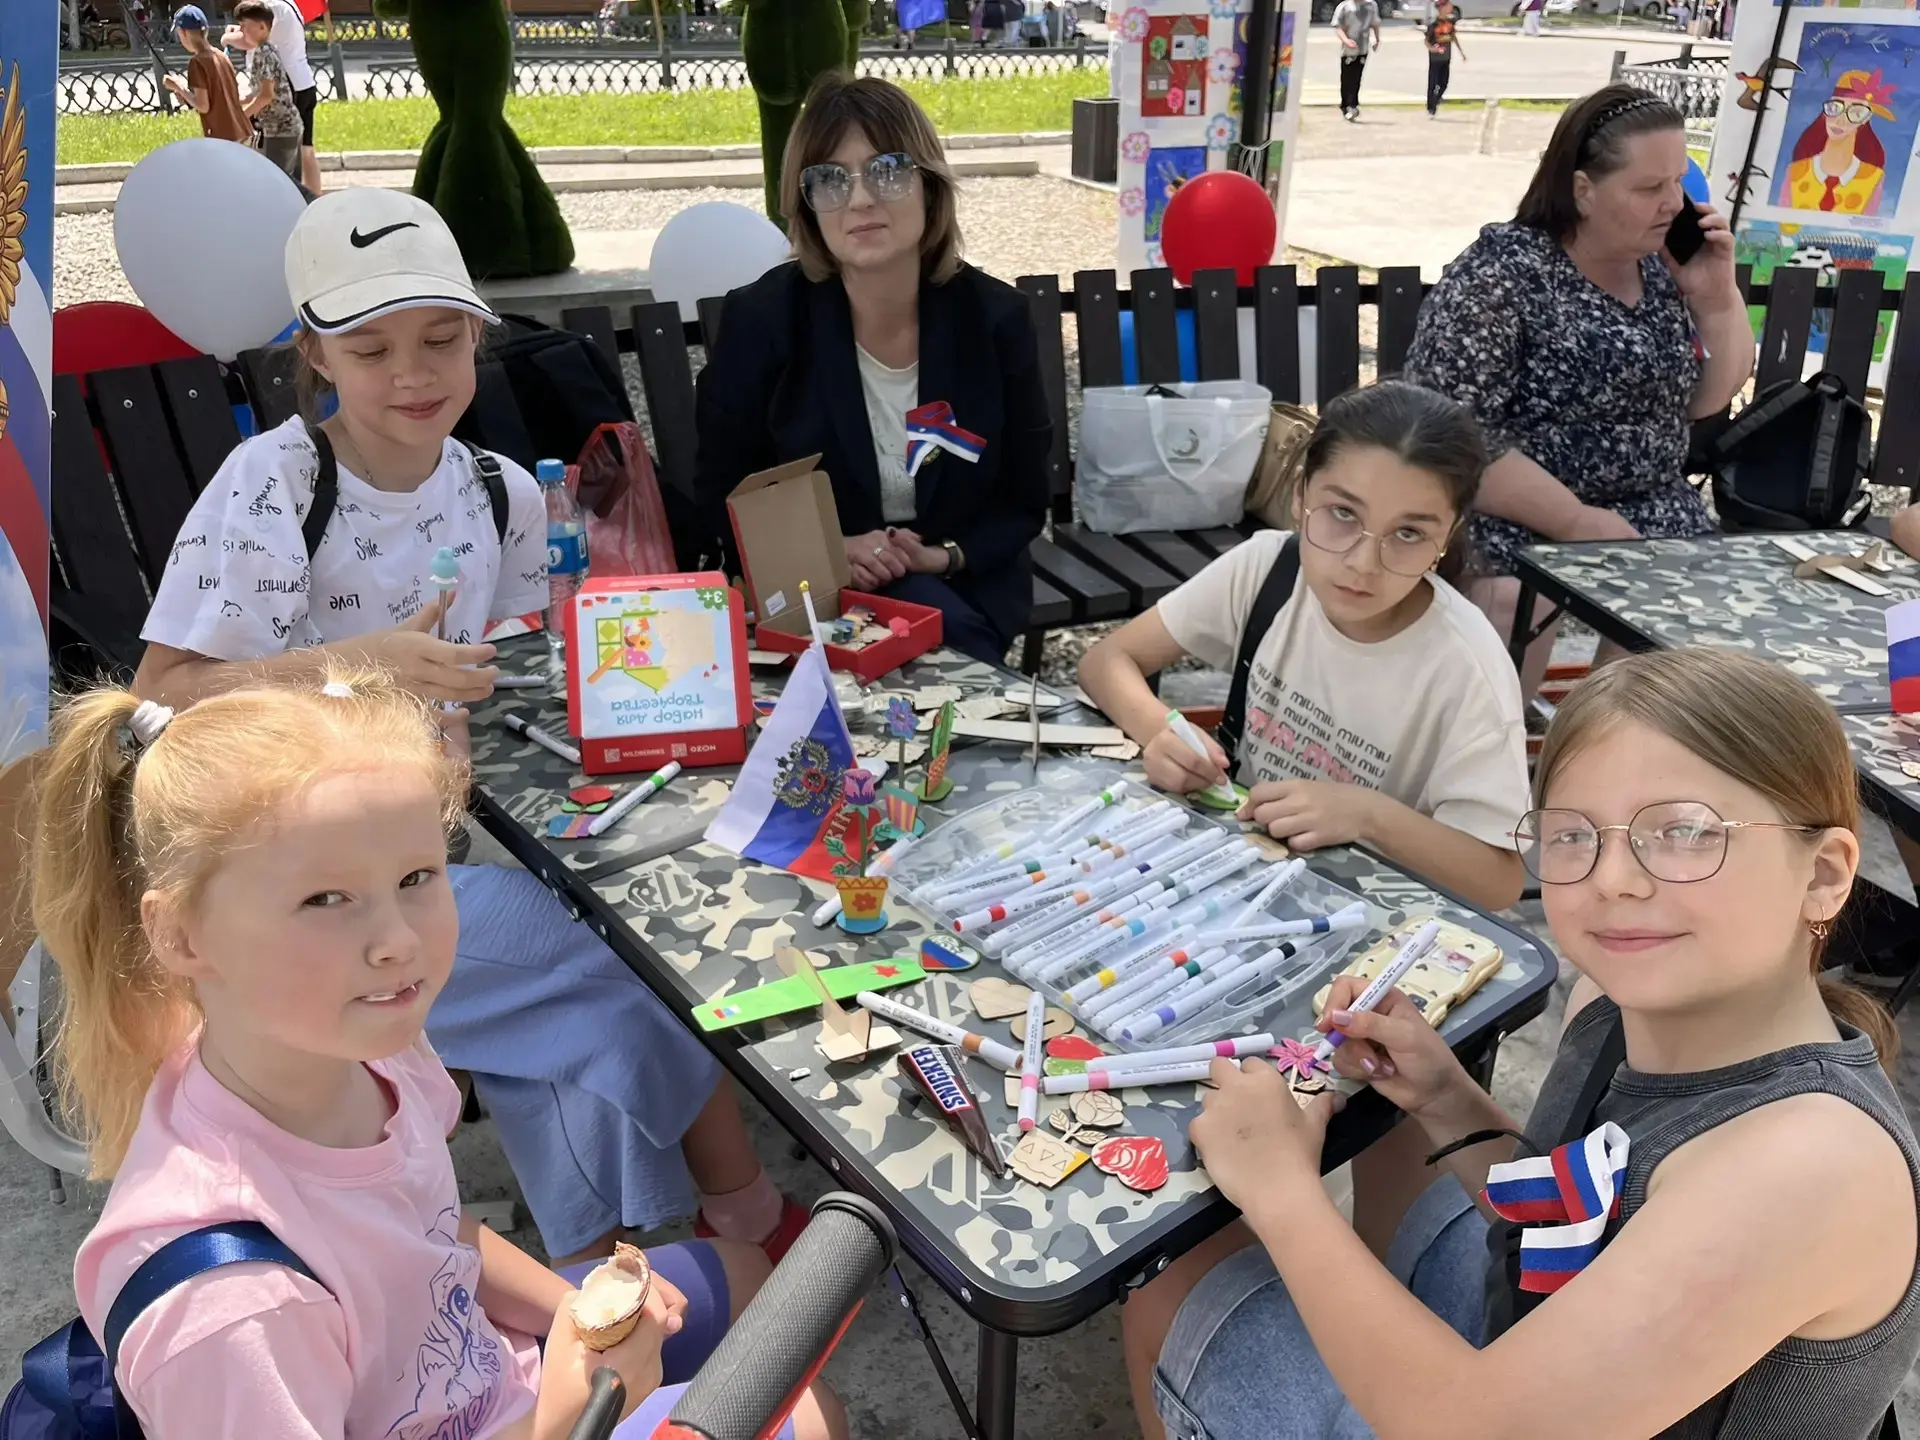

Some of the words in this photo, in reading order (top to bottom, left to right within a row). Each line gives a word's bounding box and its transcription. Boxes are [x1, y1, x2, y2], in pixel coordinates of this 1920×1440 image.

[329, 593, 362, 610] Love
[703, 589, 724, 604] 3+
[616, 712, 648, 726] для
[690, 743, 718, 754] OZON
[910, 1046, 967, 1110] SNICKER
